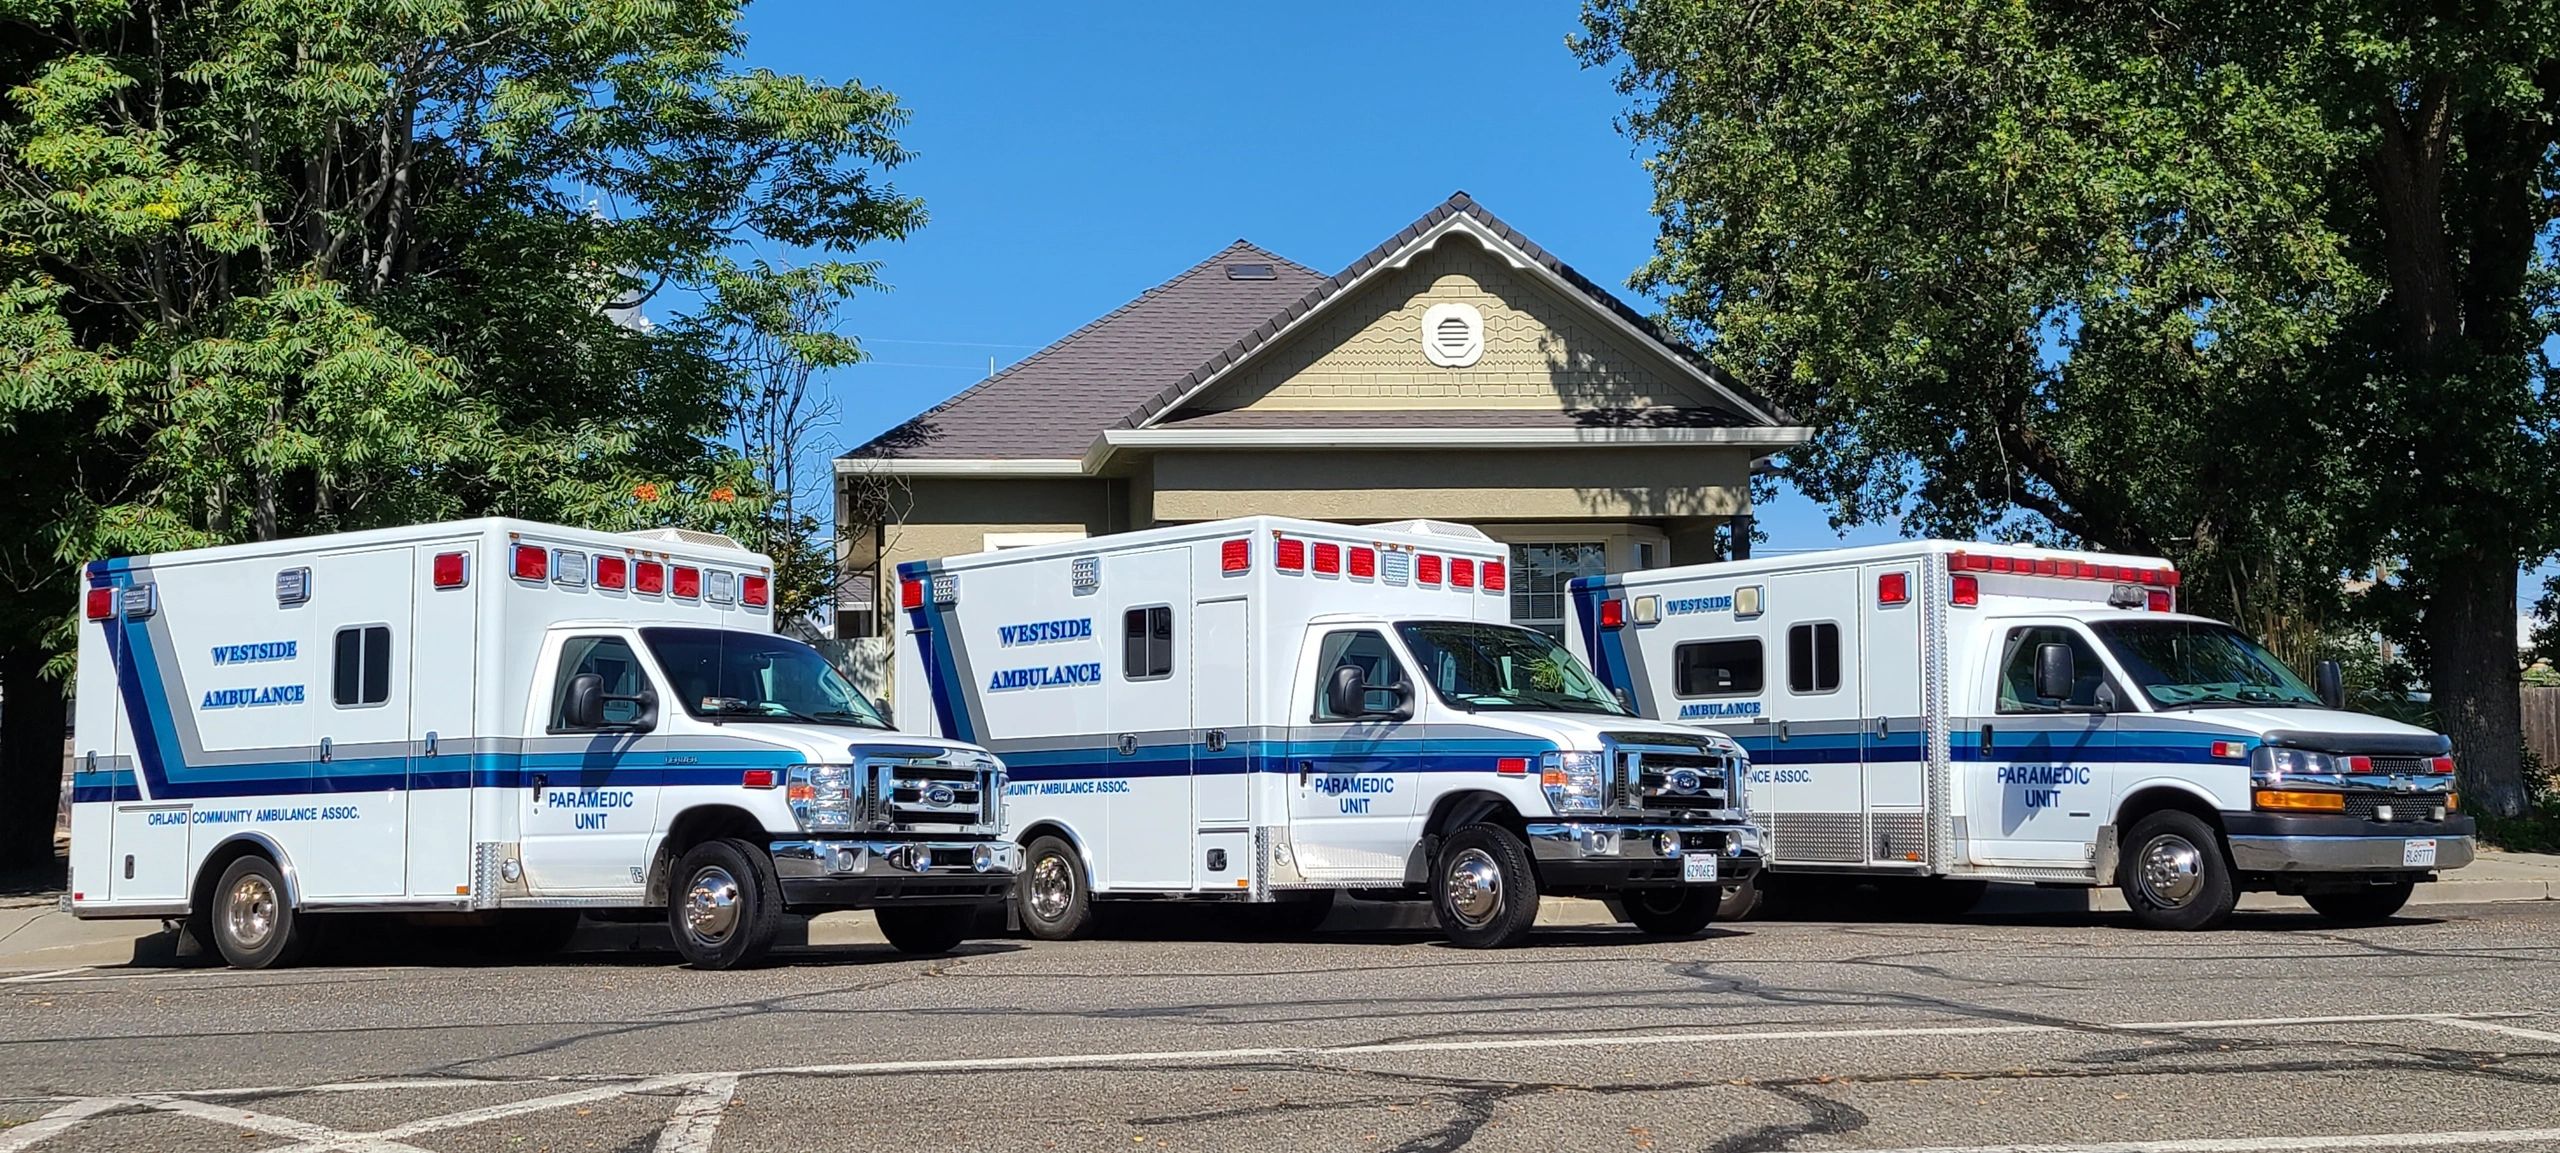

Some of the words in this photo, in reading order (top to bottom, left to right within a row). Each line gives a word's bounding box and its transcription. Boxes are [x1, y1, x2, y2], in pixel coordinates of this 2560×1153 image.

[1666, 595, 1732, 615] WESTSIDE
[998, 617, 1093, 648] WESTSIDE
[211, 640, 297, 666] WESTSIDE
[987, 662, 1101, 693] AMBULANCE
[200, 684, 304, 710] AMBULANCE
[1678, 702, 1761, 720] AMBULANCE
[1773, 769, 1812, 783] ASSOC.
[1997, 766, 2091, 785] PARAMEDIC
[1008, 783, 1039, 796] MUNITY
[1040, 781, 1094, 795] AMBULANCE
[1096, 780, 1130, 794] ASSOC.
[1315, 777, 1394, 794] PARAMEDIC
[549, 791, 634, 809] PARAMEDIC
[1340, 798, 1371, 814] UNIT
[2025, 789, 2062, 808] UNIT
[148, 812, 187, 826] ORLAND
[192, 809, 252, 824] COMMUNITY
[256, 807, 317, 822] AMBULANCE
[321, 806, 360, 820] ASSOC.
[575, 812, 608, 830] UNIT
